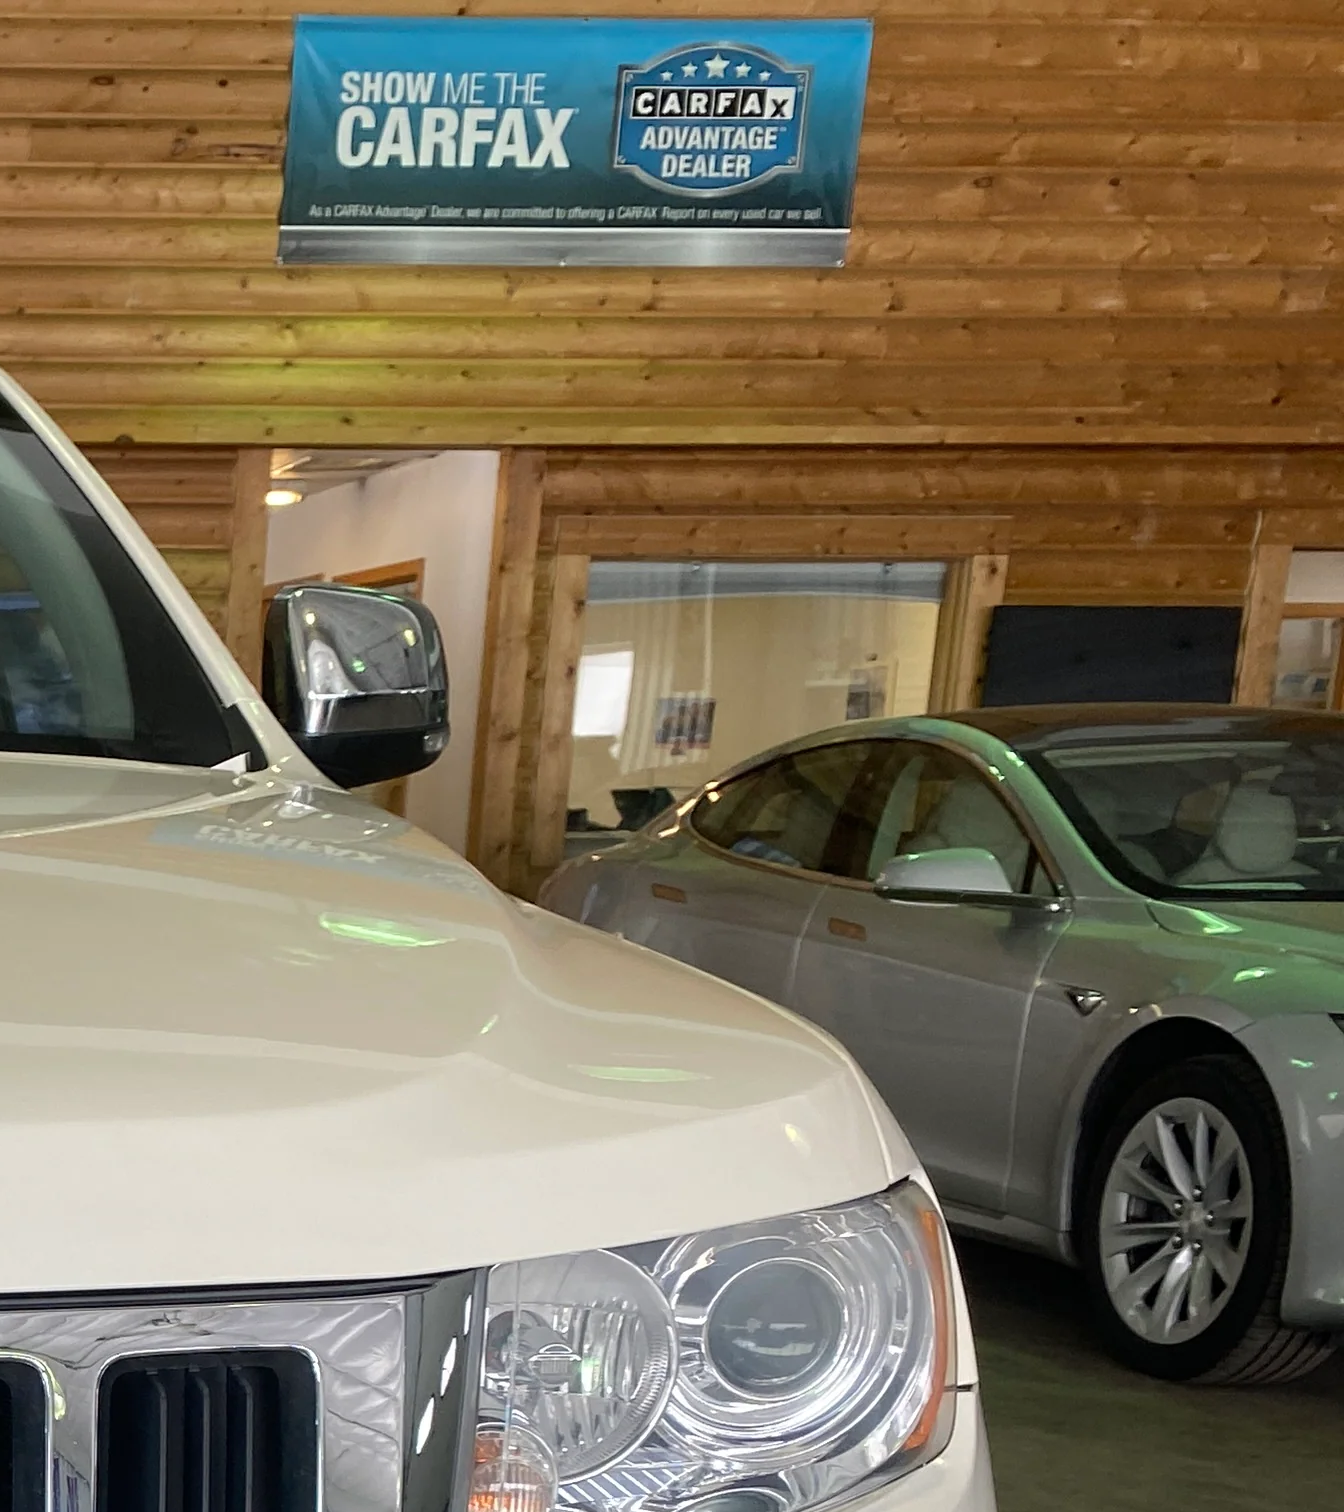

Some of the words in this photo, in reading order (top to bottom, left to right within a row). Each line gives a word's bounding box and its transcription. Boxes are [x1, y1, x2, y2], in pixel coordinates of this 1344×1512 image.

[340, 71, 436, 104] SHOW
[443, 73, 487, 104] ME
[493, 73, 547, 105] THE
[636, 91, 791, 117] CARFAX
[336, 105, 574, 169] CARFAX
[640, 126, 779, 150] ADVANTAGE
[662, 154, 752, 178] DEALER
[467, 208, 482, 218] we
[483, 208, 501, 218] are
[502, 207, 554, 219] committed
[555, 208, 566, 219] to
[567, 206, 606, 222] offering
[662, 206, 695, 220] Report
[697, 209, 711, 219] on
[712, 209, 740, 221] every
[741, 207, 767, 219] used
[768, 209, 785, 219] car
[786, 209, 802, 219] we
